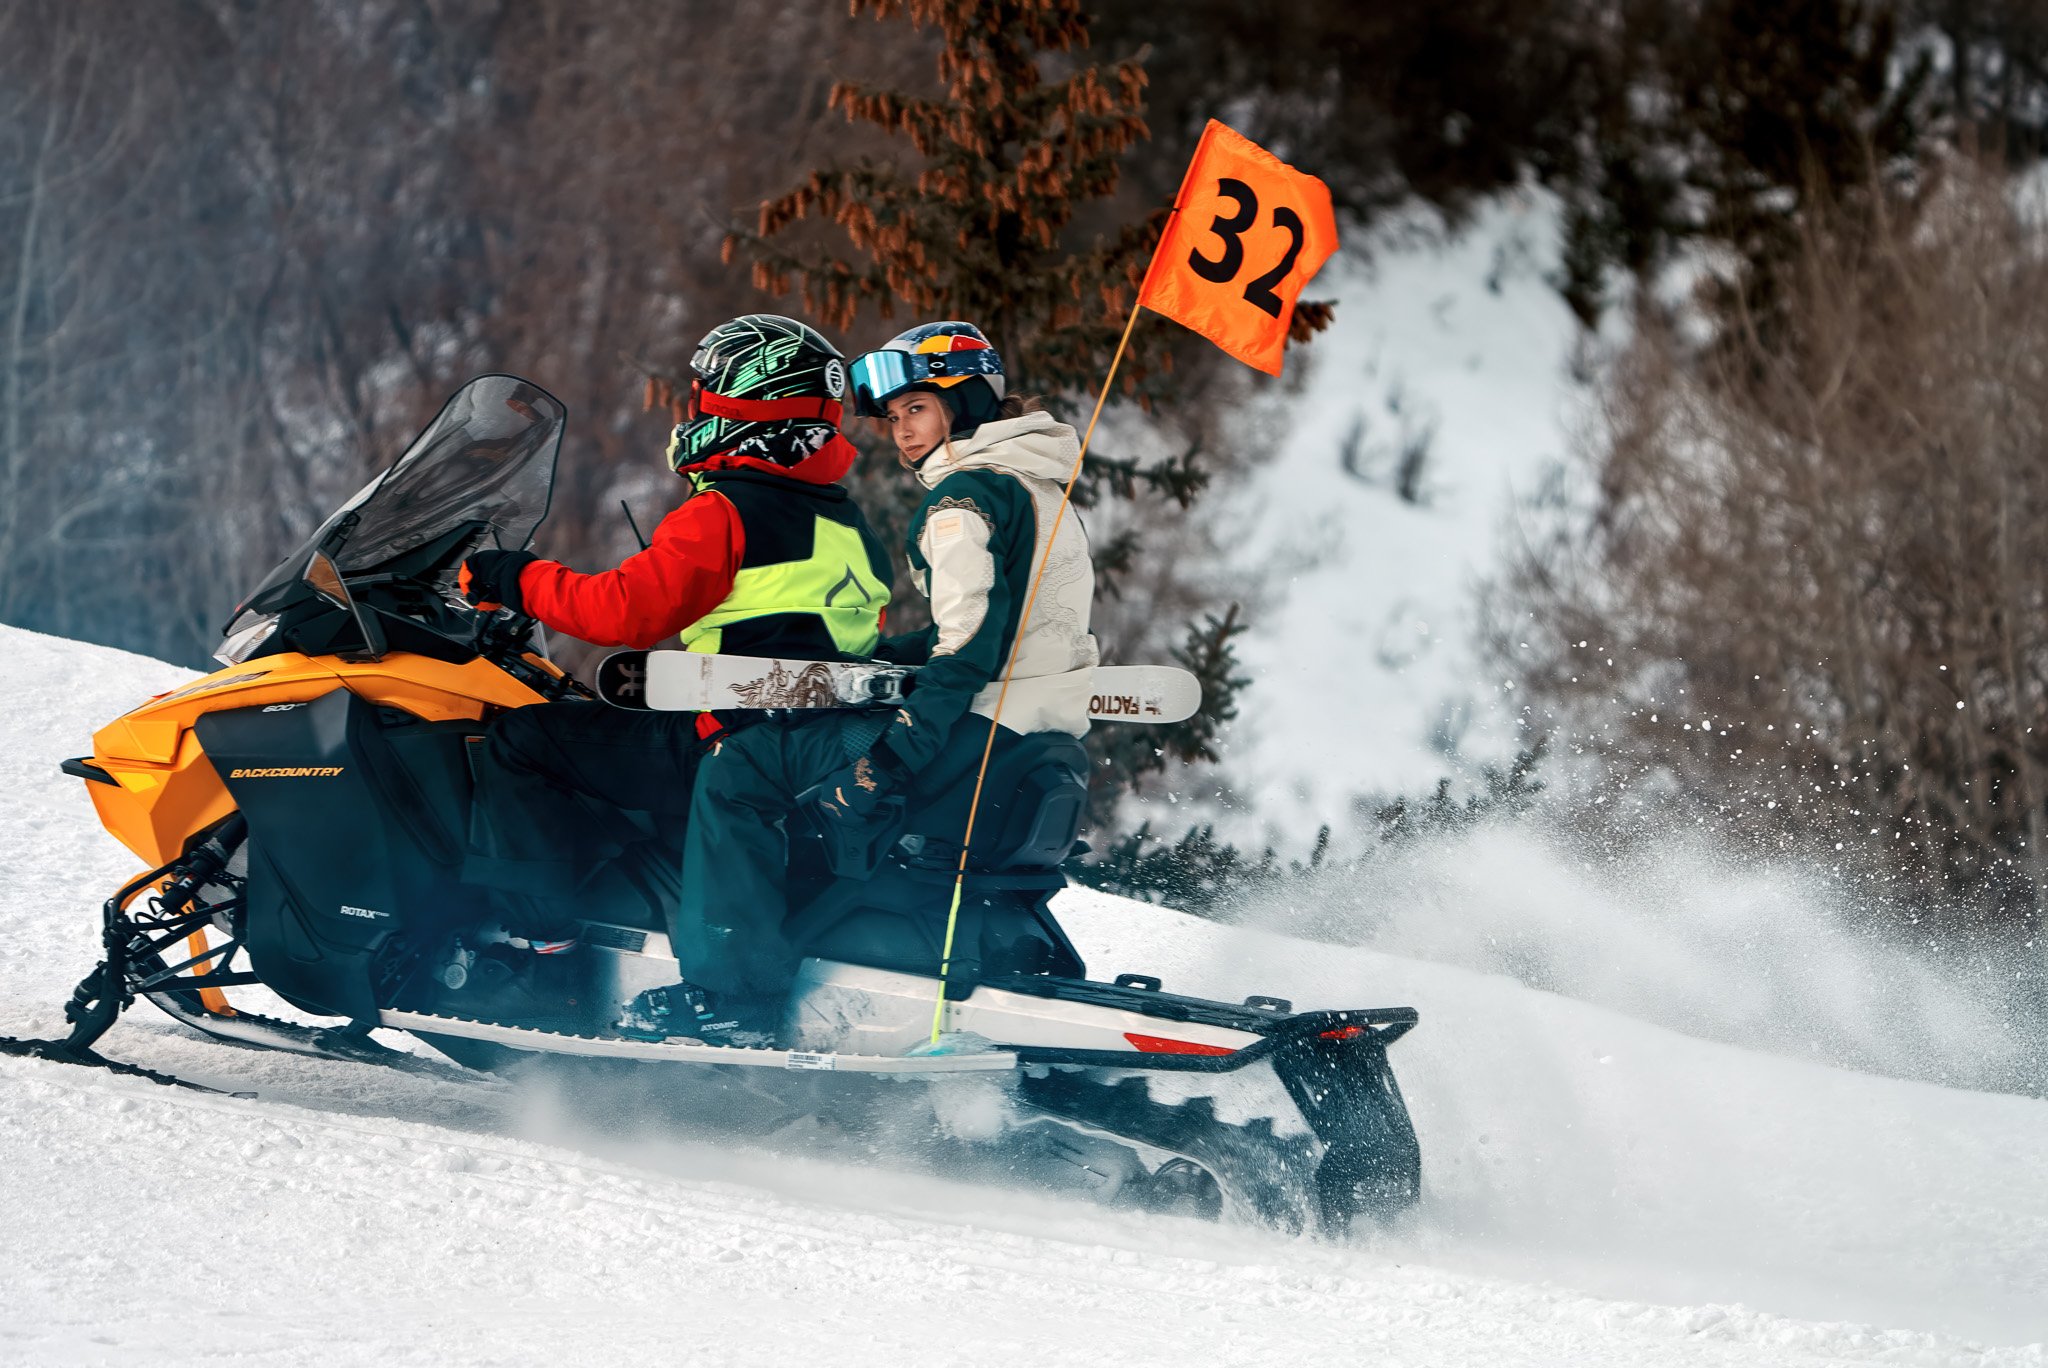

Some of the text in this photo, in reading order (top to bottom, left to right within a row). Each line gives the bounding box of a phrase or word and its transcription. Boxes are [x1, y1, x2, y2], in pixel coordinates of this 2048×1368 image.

[1188, 177, 1304, 320] 32
[262, 703, 296, 712] 600
[1089, 694, 1140, 715] FACTIO
[230, 767, 344, 778] BACKCOUNTRY
[340, 905, 376, 919] ROTAX
[700, 1020, 739, 1031] ATOMIC
